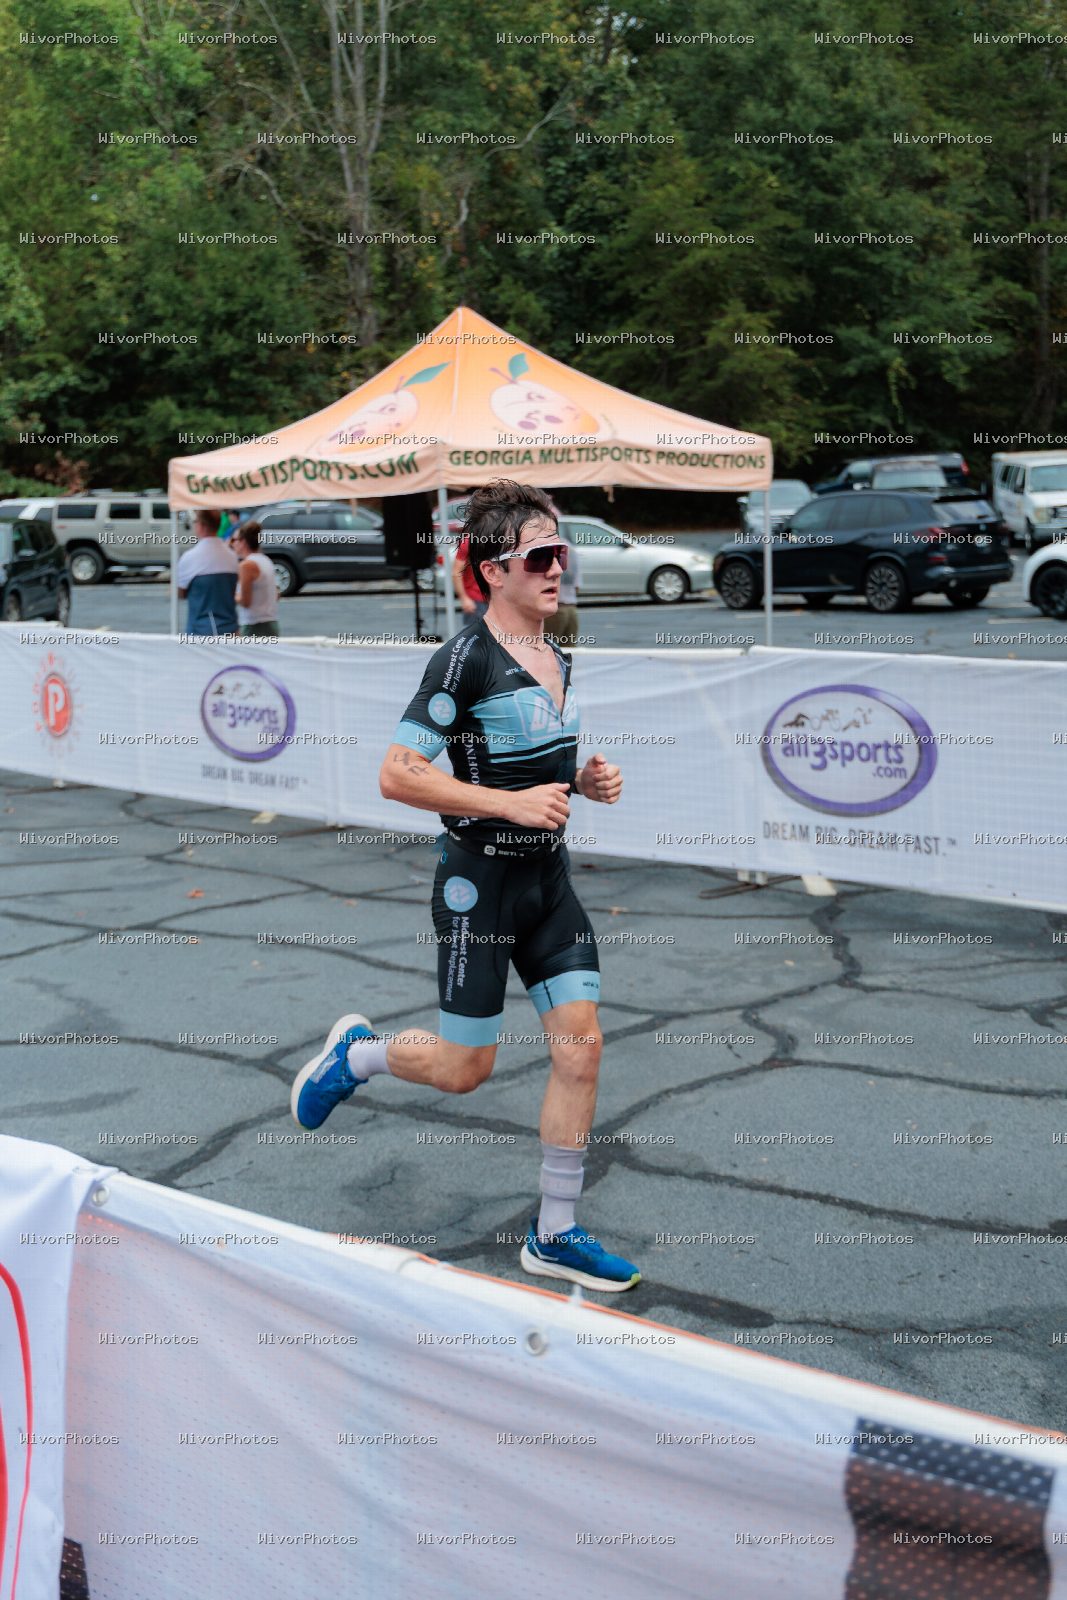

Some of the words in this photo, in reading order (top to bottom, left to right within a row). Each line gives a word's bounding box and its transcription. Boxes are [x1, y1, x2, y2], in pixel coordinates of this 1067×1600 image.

[449, 449, 534, 466] GEORGIA
[539, 447, 650, 466] MULTISPORTS
[656, 450, 766, 469] PRODUCTIONS
[442, 655, 458, 690] Midwest
[463, 738, 480, 787] OOFING
[763, 821, 810, 843] DREAM
[452, 916, 460, 929] for
[460, 916, 470, 956] Midest
[444, 950, 458, 1002] Replacement
[457, 957, 468, 988] Center
